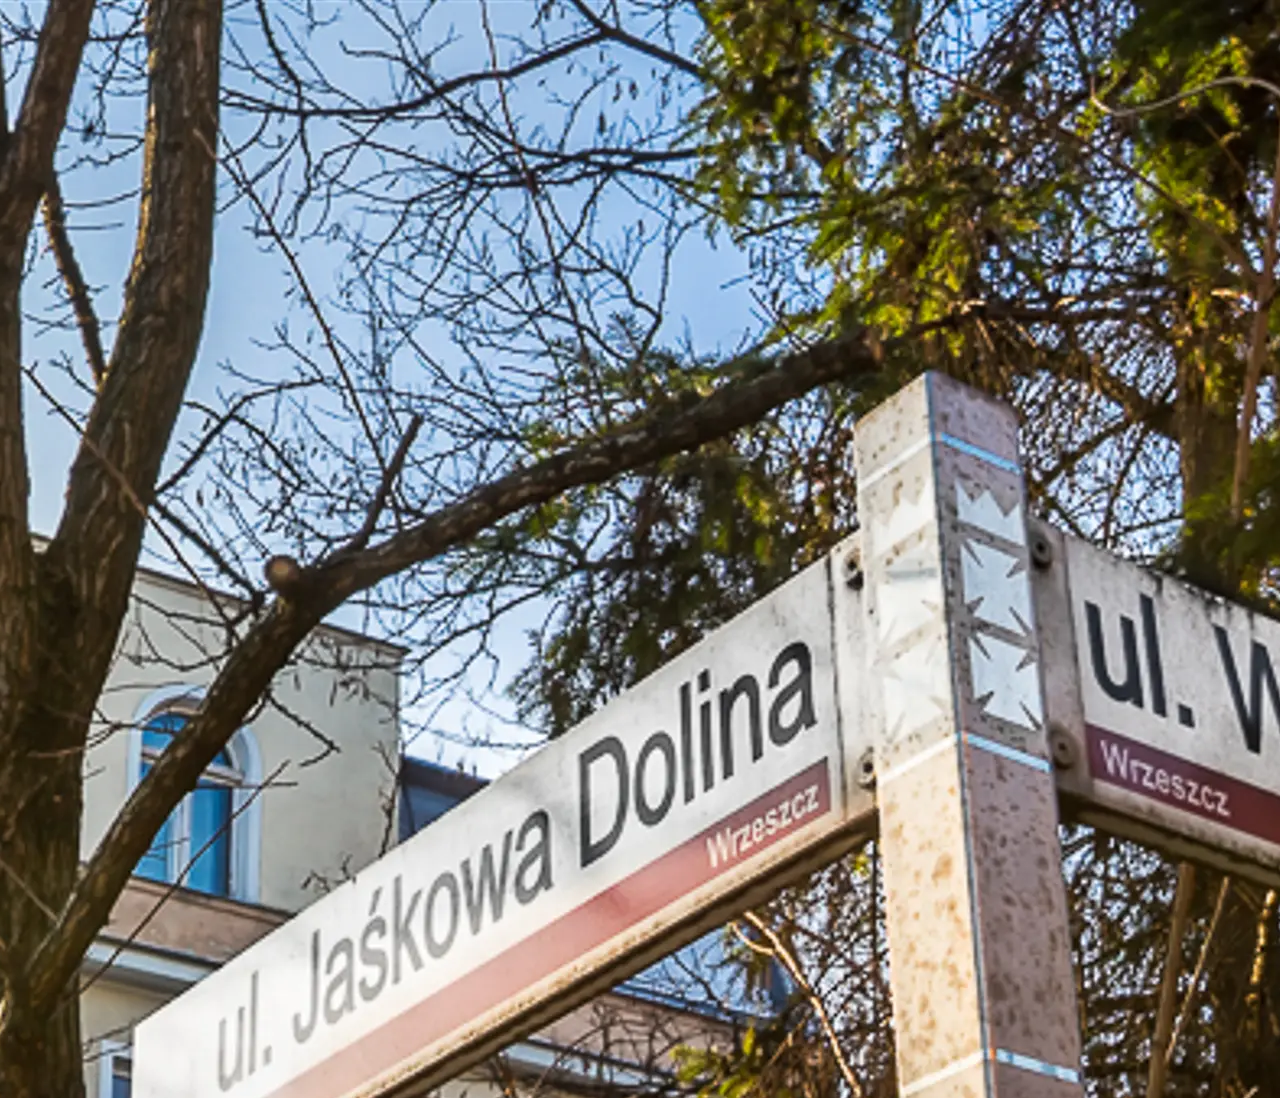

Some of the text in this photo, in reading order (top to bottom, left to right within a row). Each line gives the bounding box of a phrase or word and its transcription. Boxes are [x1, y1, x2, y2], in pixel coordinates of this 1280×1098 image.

[1084, 593, 1195, 728] ul.
[705, 784, 820, 869] Wrzeszcz
[1100, 739, 1233, 817] Wrzeszcz
[217, 641, 818, 1093] ul. Jaśkowa Dolina
